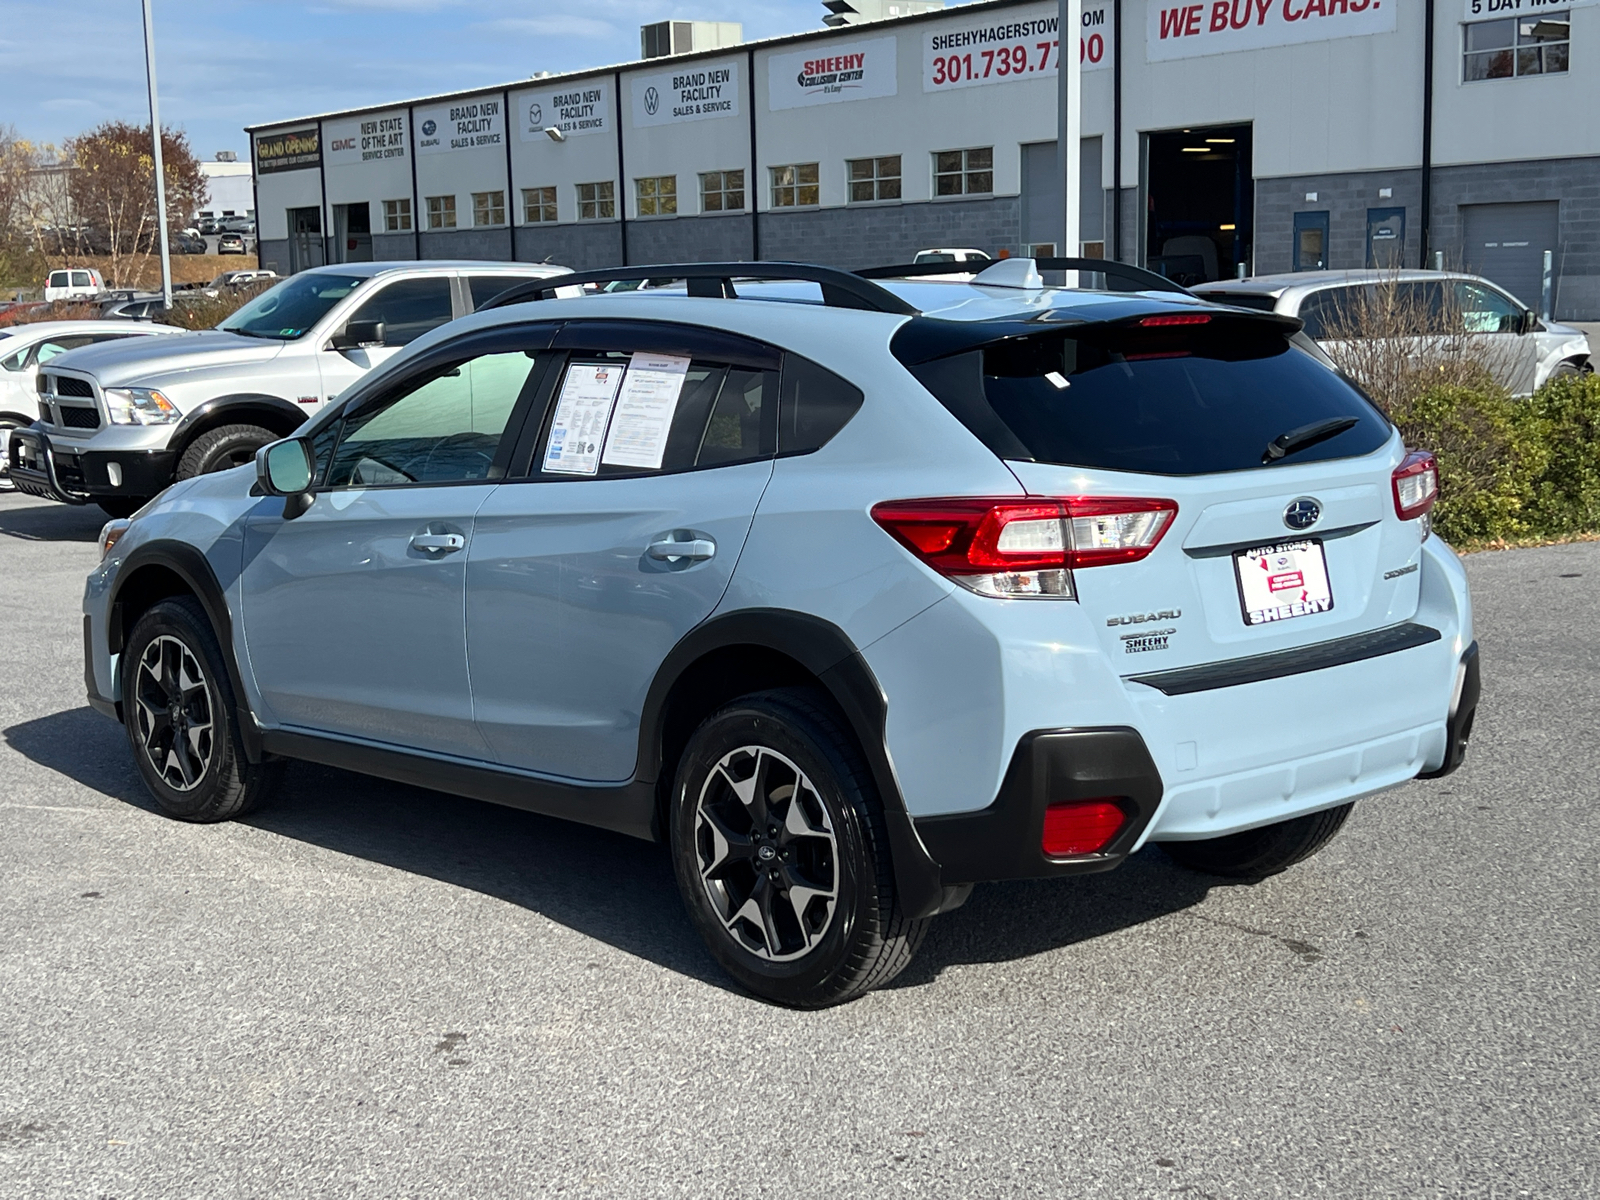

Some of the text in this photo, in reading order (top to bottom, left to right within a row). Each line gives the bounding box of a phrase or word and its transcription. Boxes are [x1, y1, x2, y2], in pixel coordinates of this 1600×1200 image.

[1160, 0, 1380, 39] WE BUY CAR
[804, 53, 865, 76] SHEEHY
[673, 69, 730, 90] BRAND NEW
[838, 69, 864, 83] CENTER
[553, 89, 601, 108] BRAND NEW
[681, 85, 721, 103] FACILITY
[450, 101, 499, 121] BRAND NEW
[560, 104, 595, 120] FACILITY
[673, 100, 731, 117] SALES & SERVICE
[361, 117, 403, 136] NEW STATE
[457, 117, 492, 135] FACILITY
[572, 121, 577, 130] &
[578, 118, 602, 130] SERVICE
[258, 136, 318, 159] GRAND OPENING
[331, 137, 356, 152] GMC
[361, 132, 404, 151] OF THE ART
[451, 133, 501, 149] SALES & SERVICE
[362, 146, 404, 161] SERVICE CENTER
[1106, 608, 1182, 627] SUBARU
[1249, 598, 1331, 625] SHEEHY
[1125, 636, 1169, 649] SHEEHY
